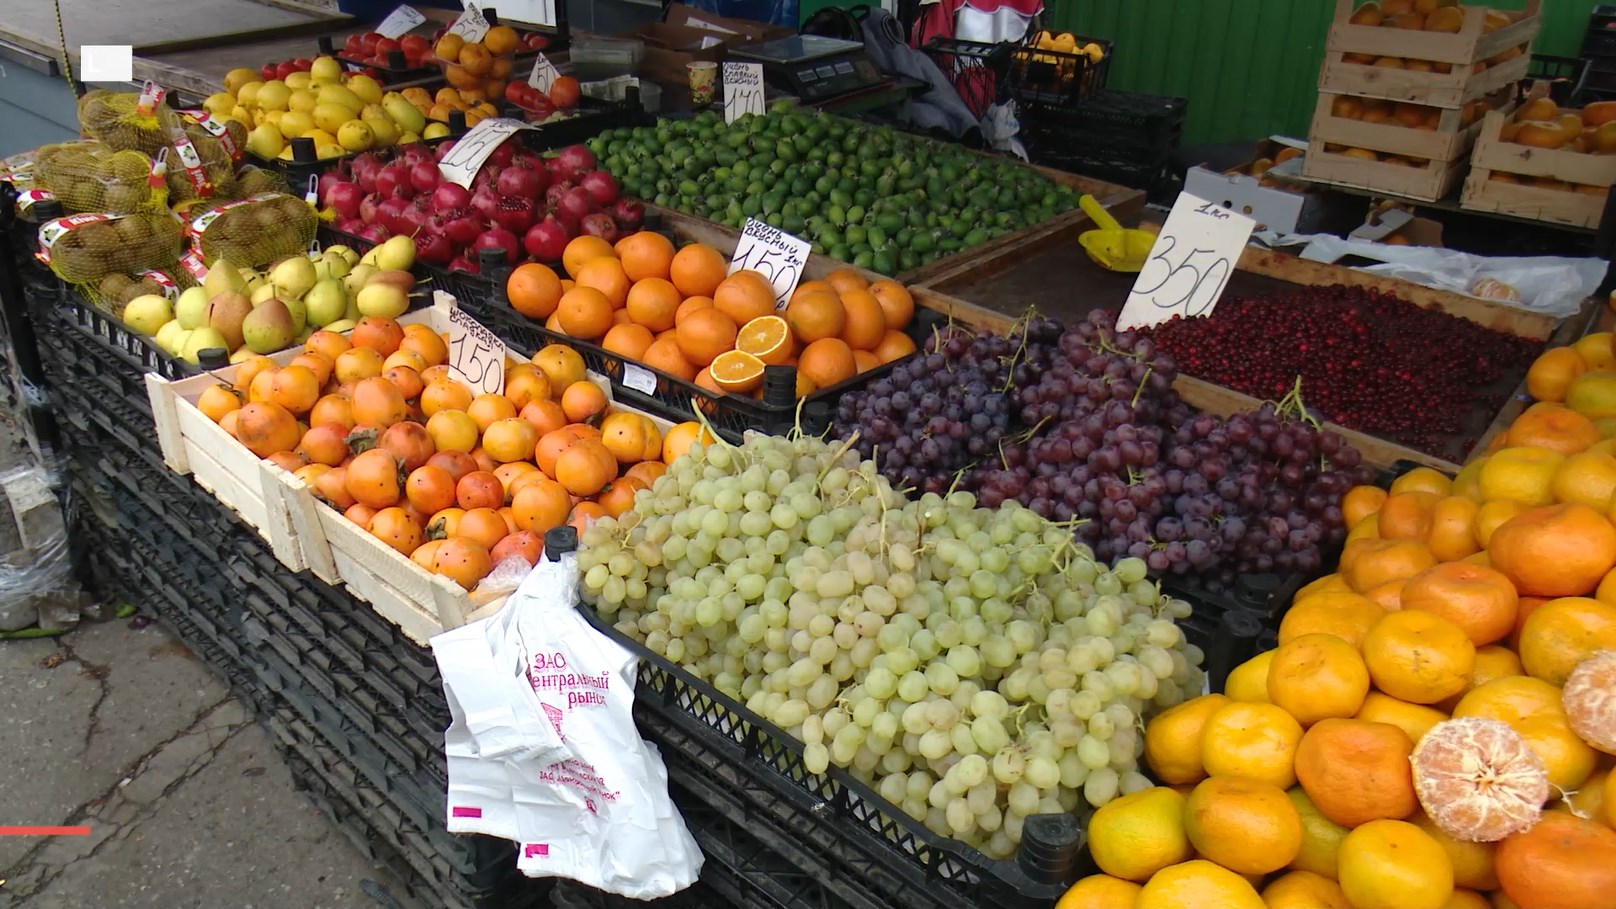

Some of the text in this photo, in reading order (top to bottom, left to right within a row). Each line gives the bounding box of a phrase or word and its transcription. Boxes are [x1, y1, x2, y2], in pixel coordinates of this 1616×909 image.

[744, 227, 799, 254] ВКУСНЫЙ
[746, 219, 782, 240] ОЧЕНЬ
[733, 244, 797, 301] 150
[1131, 235, 1230, 317] 350
[449, 334, 502, 394] 150
[533, 652, 567, 670] ЗАО
[530, 671, 610, 692] ентральный
